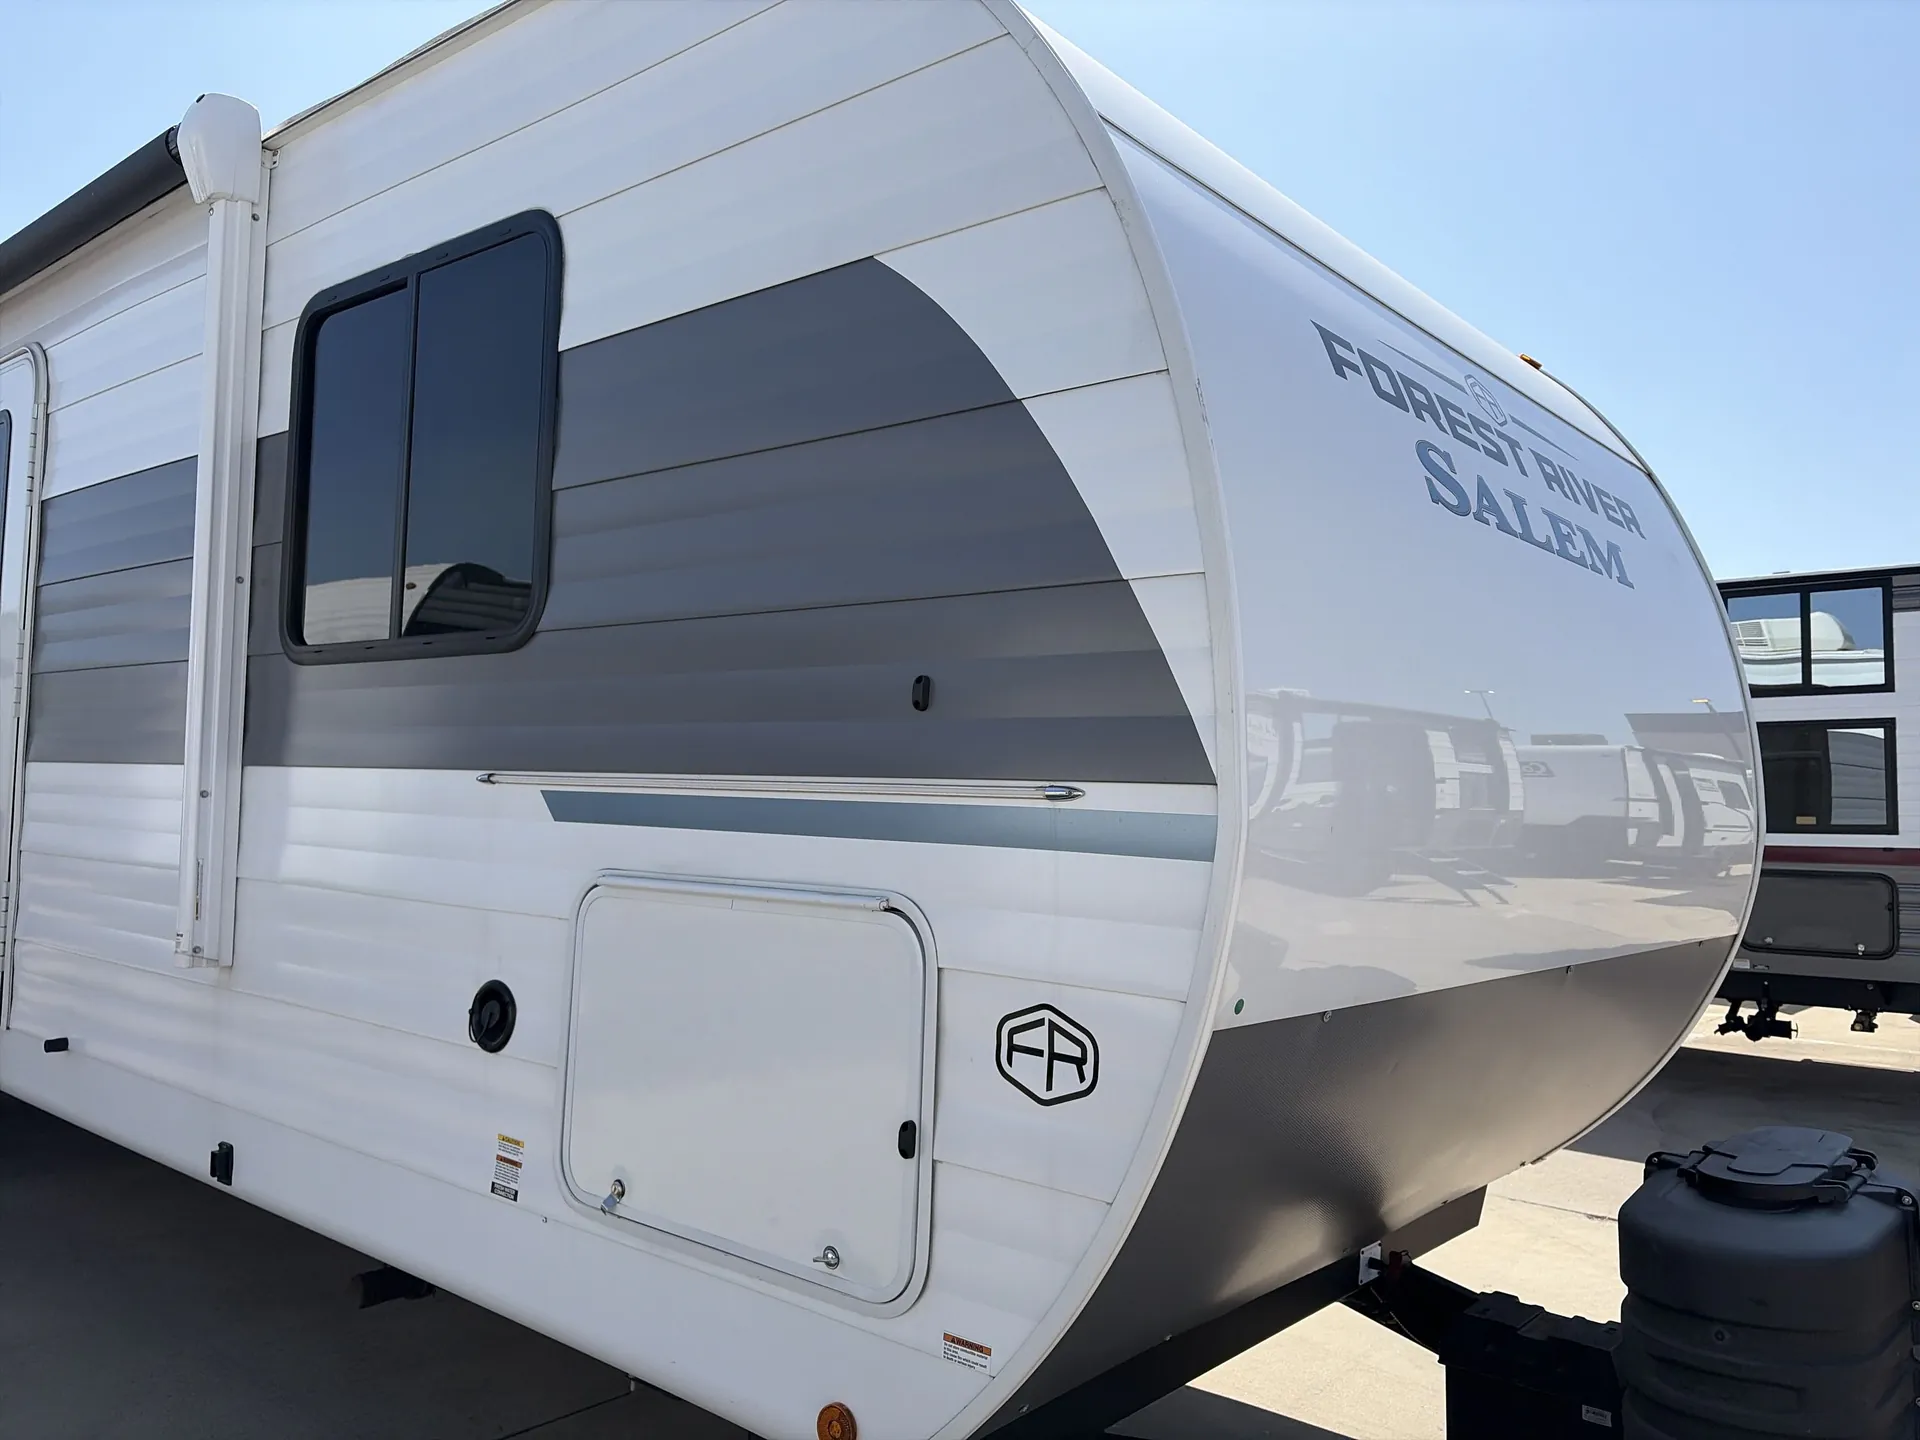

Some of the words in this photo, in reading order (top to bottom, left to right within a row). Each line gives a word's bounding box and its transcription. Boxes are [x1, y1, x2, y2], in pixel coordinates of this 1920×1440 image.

[1310, 319, 1529, 478] FOREST
[1528, 447, 1647, 540] RIVER
[1415, 439, 1635, 590] SALEM
[1006, 1017, 1088, 1092] FR
[954, 1337, 984, 1353] WARNING
